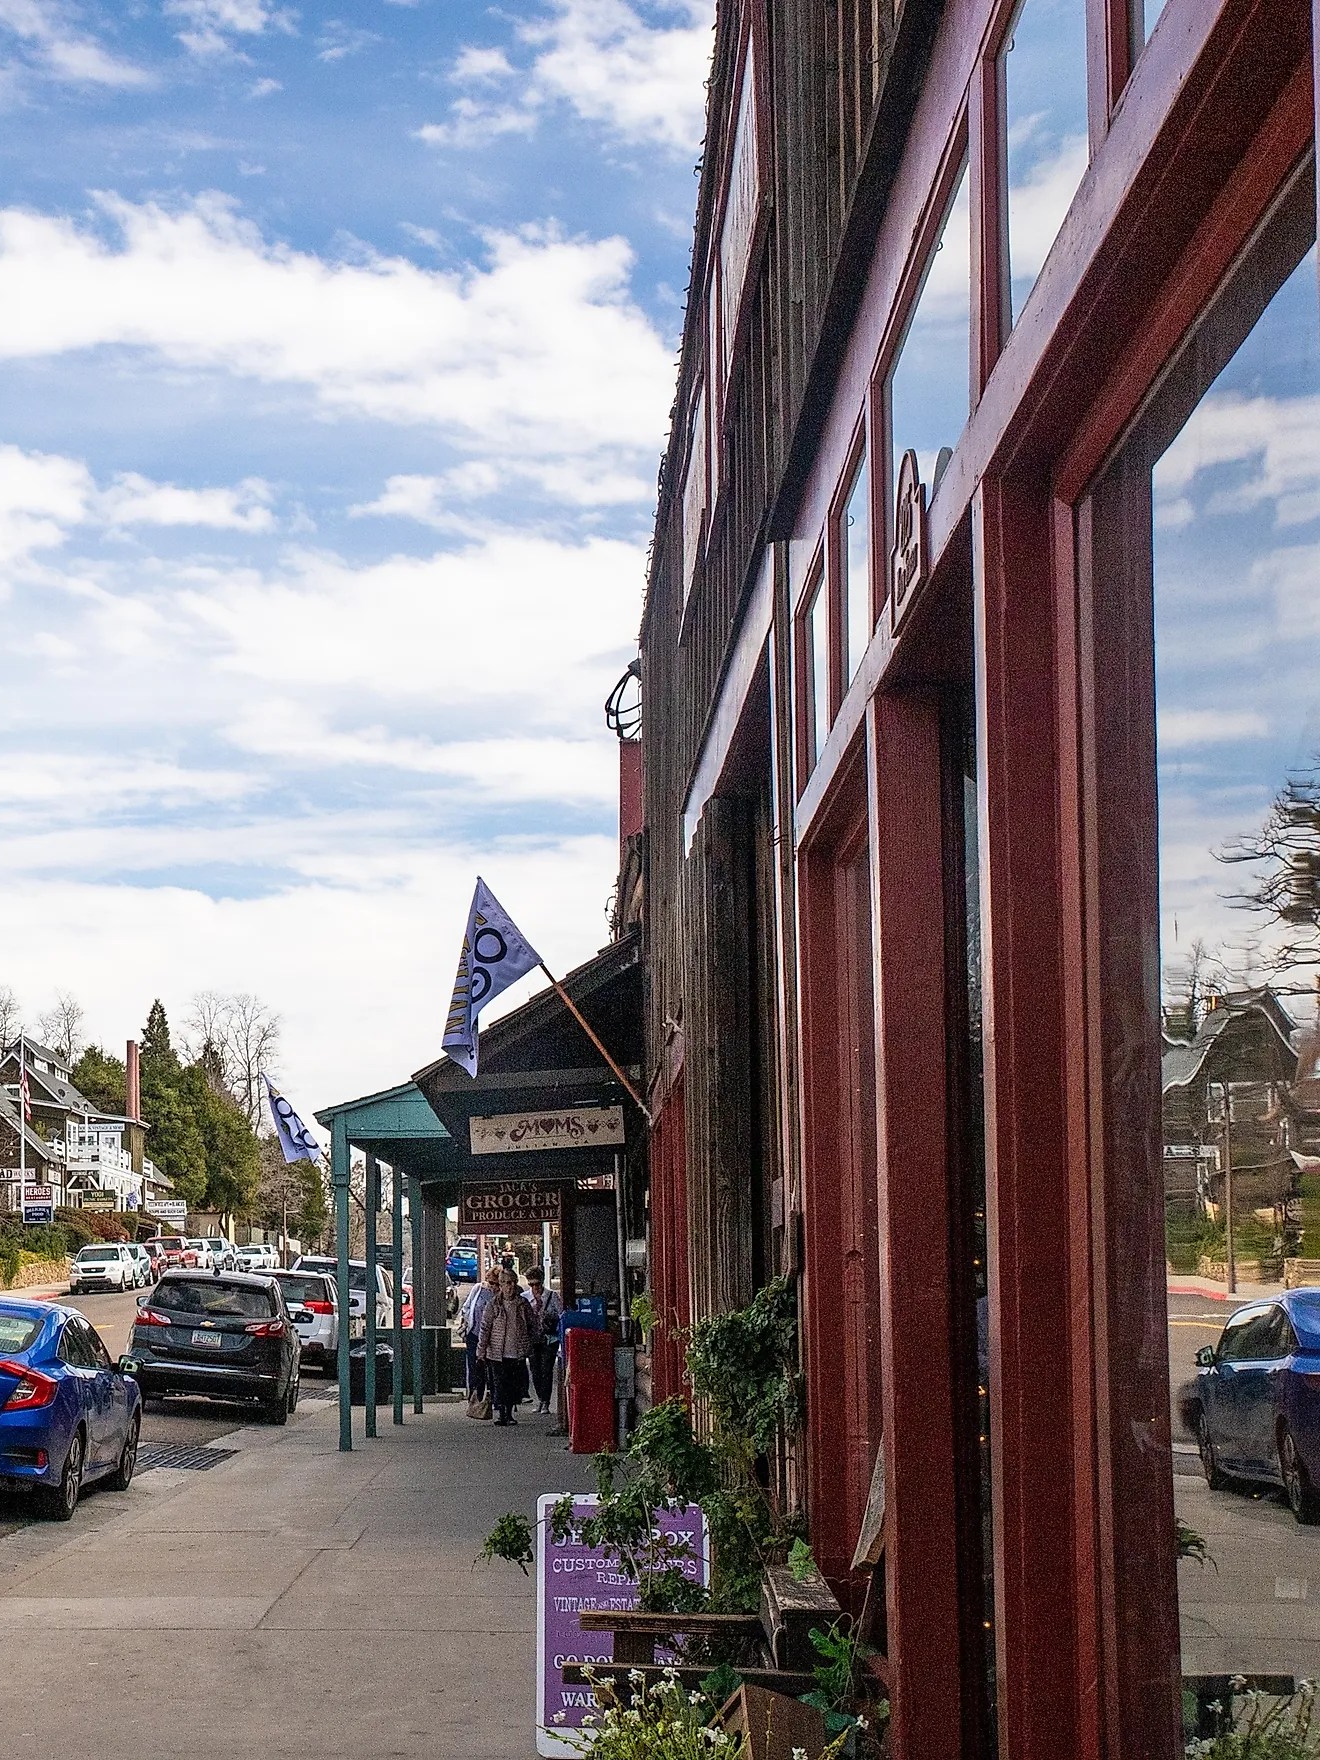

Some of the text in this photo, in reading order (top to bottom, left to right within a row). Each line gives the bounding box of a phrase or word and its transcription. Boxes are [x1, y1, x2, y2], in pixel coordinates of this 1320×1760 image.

[25, 1187, 51, 1196] HEROES
[499, 1181, 538, 1193] JACK'S
[466, 1191, 560, 1210] GROCER
[472, 1209, 527, 1221] PRODUCE
[530, 1209, 538, 1219] &
[553, 1558, 619, 1573] CUSTOM
[554, 1596, 596, 1612] VINTAGE
[610, 1597, 641, 1612] ESTAT
